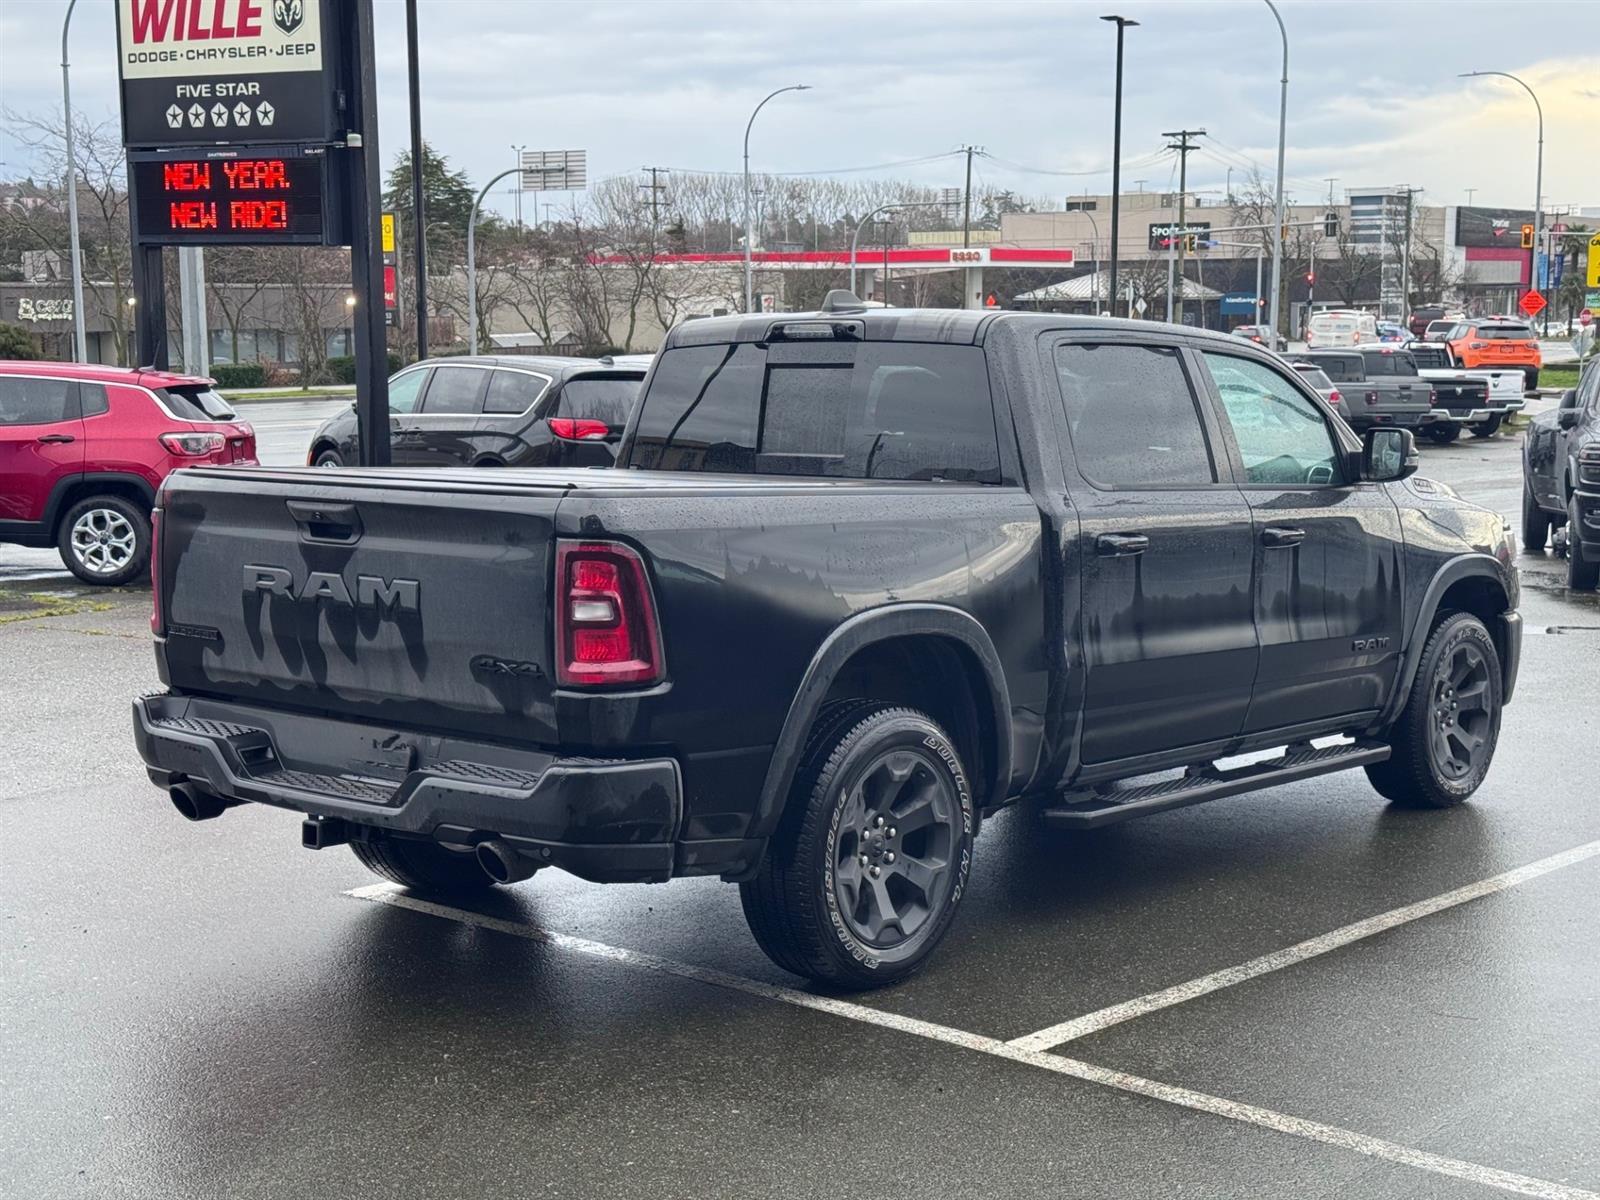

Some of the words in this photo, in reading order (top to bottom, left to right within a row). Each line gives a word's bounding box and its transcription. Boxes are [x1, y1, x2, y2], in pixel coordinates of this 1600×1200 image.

[131, 0, 262, 44] WILLE
[176, 84, 211, 98] FIVE
[215, 82, 260, 97] STAR
[164, 162, 211, 191] NEW
[170, 201, 218, 229] NEW
[230, 200, 288, 229] RIDE!
[243, 563, 422, 611] RAM
[1352, 636, 1391, 651] RAM
